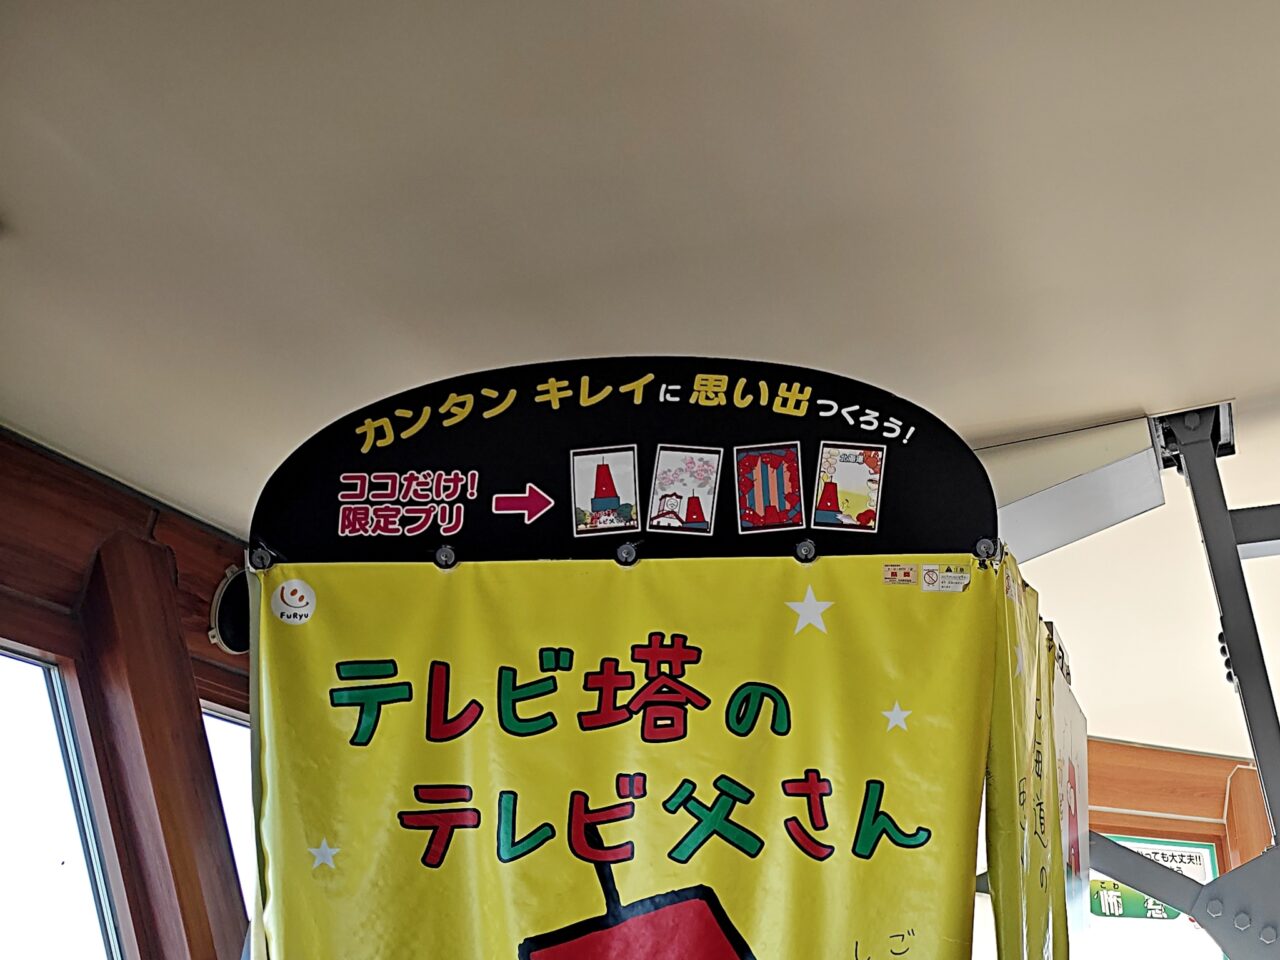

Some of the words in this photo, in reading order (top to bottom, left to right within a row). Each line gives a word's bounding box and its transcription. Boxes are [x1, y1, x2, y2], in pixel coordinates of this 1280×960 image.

[355, 388, 518, 454] カンタン
[338, 470, 479, 501] ココだけ!
[338, 503, 464, 536] 限定プリ
[329, 632, 792, 747] テレビ塔の
[398, 768, 931, 868] テレビ父さん
